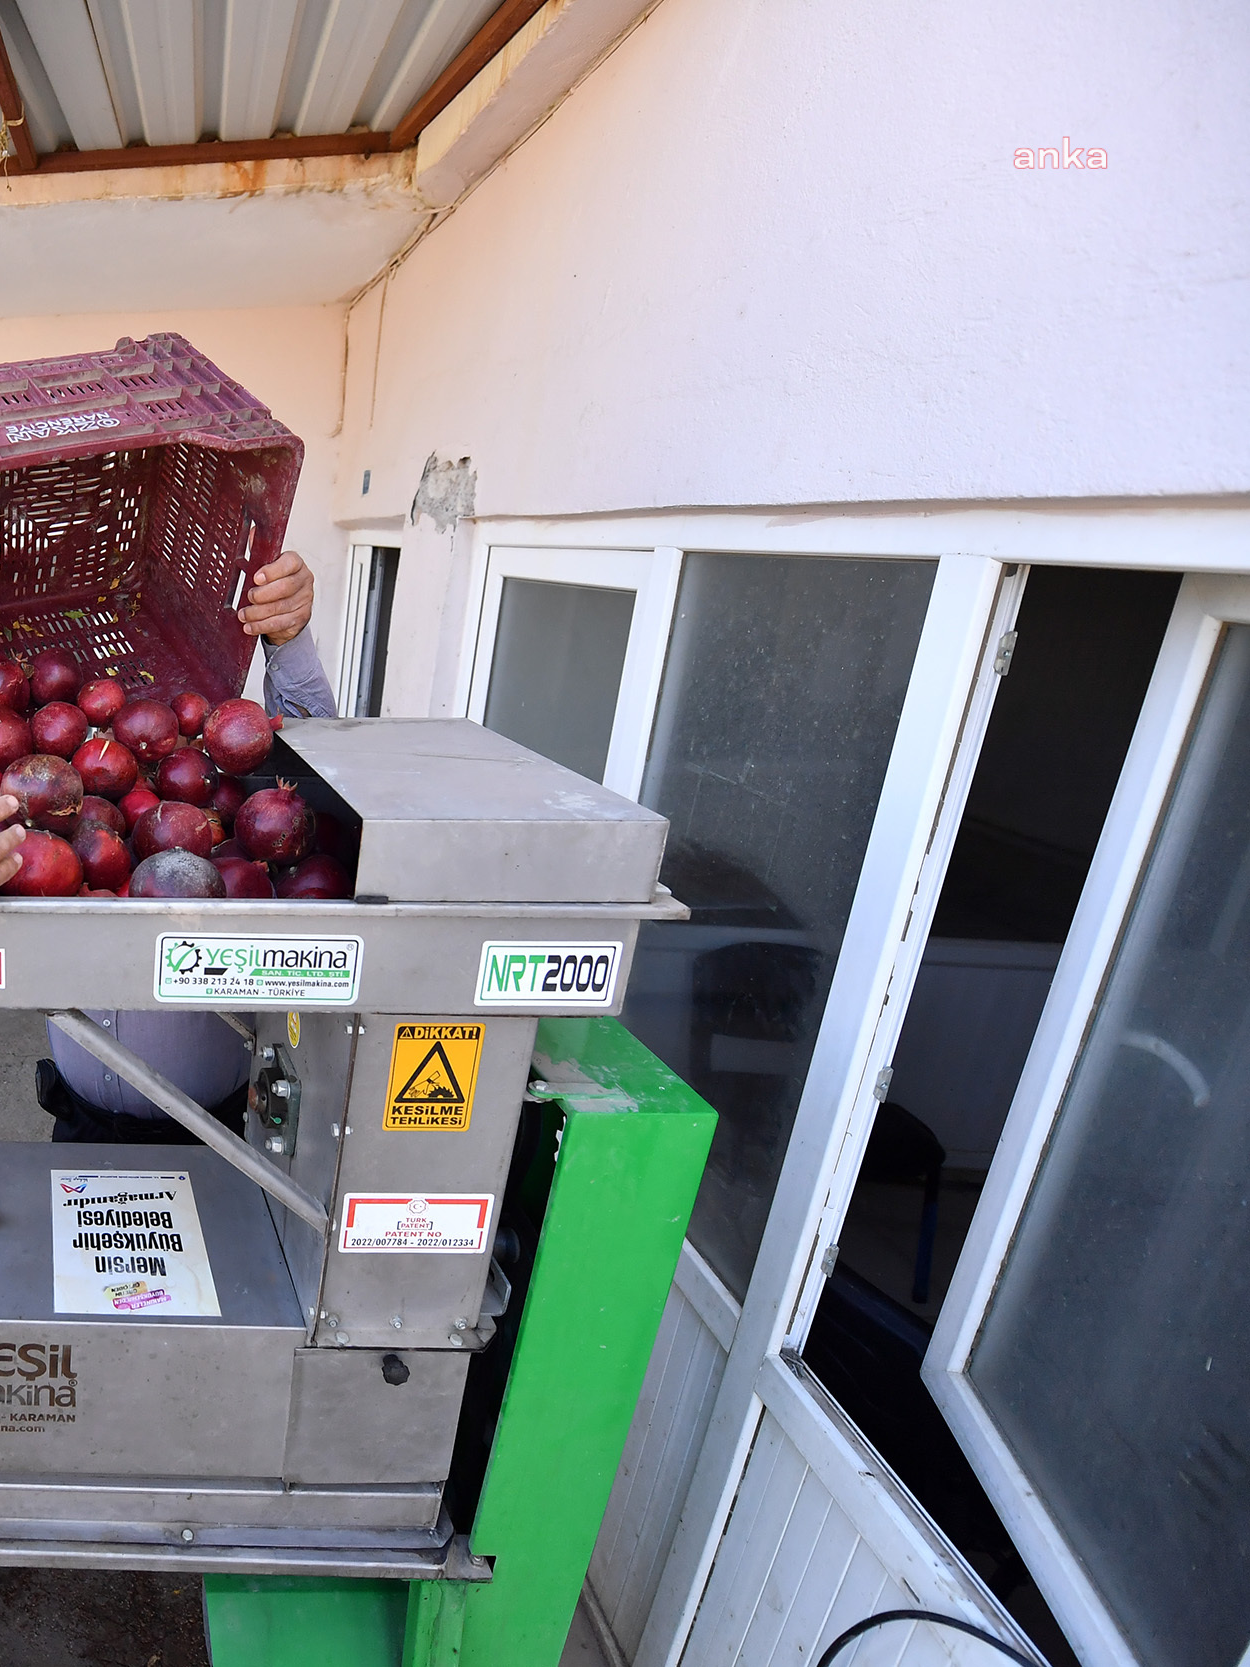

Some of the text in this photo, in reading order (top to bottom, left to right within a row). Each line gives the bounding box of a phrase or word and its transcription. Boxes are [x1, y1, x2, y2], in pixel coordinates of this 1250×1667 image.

[487, 954, 609, 992] NRT2000
[173, 977, 350, 989] +90 338 213 24 18 www.yesilmakina.com
[214, 987, 260, 996] KARAMAN
[268, 986, 306, 997] TÜRKİYE
[62, 1191, 177, 1209] Armağanıdır
[77, 1209, 174, 1229] Belediyesi
[72, 1230, 184, 1252] Büyükşehir
[351, 1238, 408, 1246] 2022/007784
[417, 1238, 474, 1247] 2022/012334
[95, 1256, 167, 1277] Mersin
[9, 1413, 76, 1423] KARAMAN
